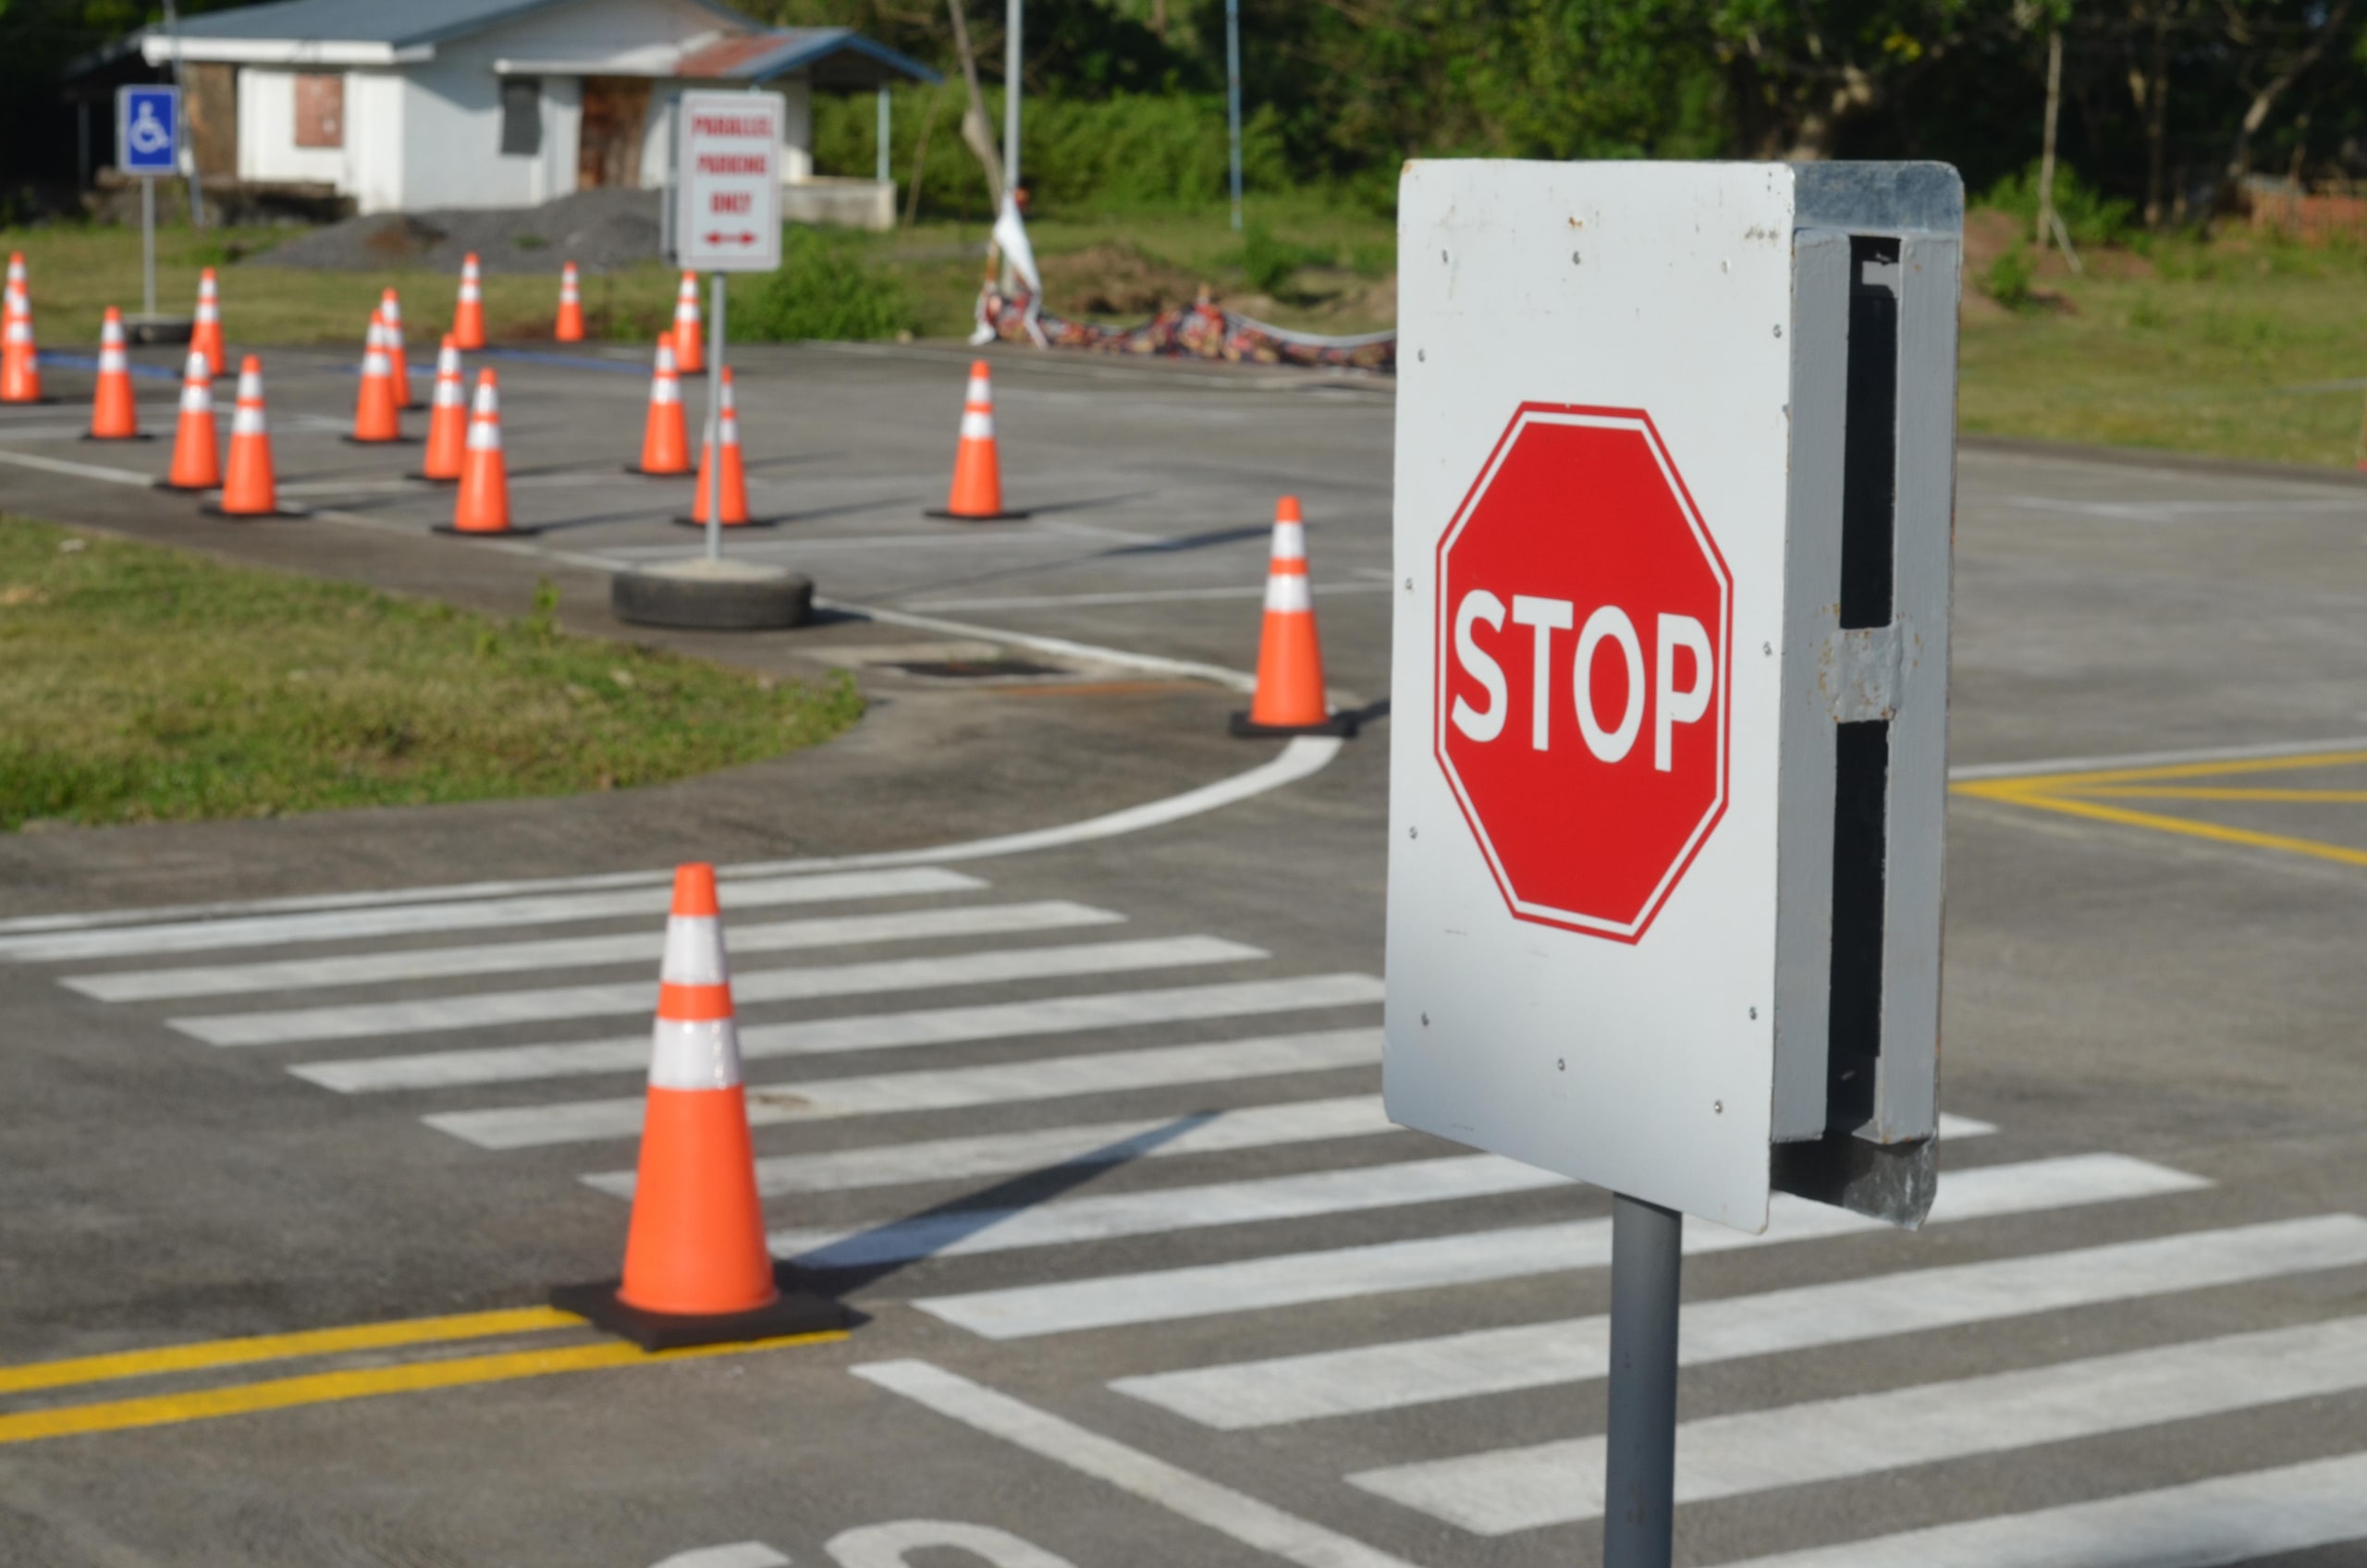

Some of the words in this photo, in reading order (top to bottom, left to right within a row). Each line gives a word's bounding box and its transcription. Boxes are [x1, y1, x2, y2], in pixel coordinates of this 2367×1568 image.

[692, 116, 775, 136] PARALLEL
[696, 153, 768, 175] PARKING
[709, 191, 754, 214] ONLY
[1451, 589, 1714, 773] STOP
